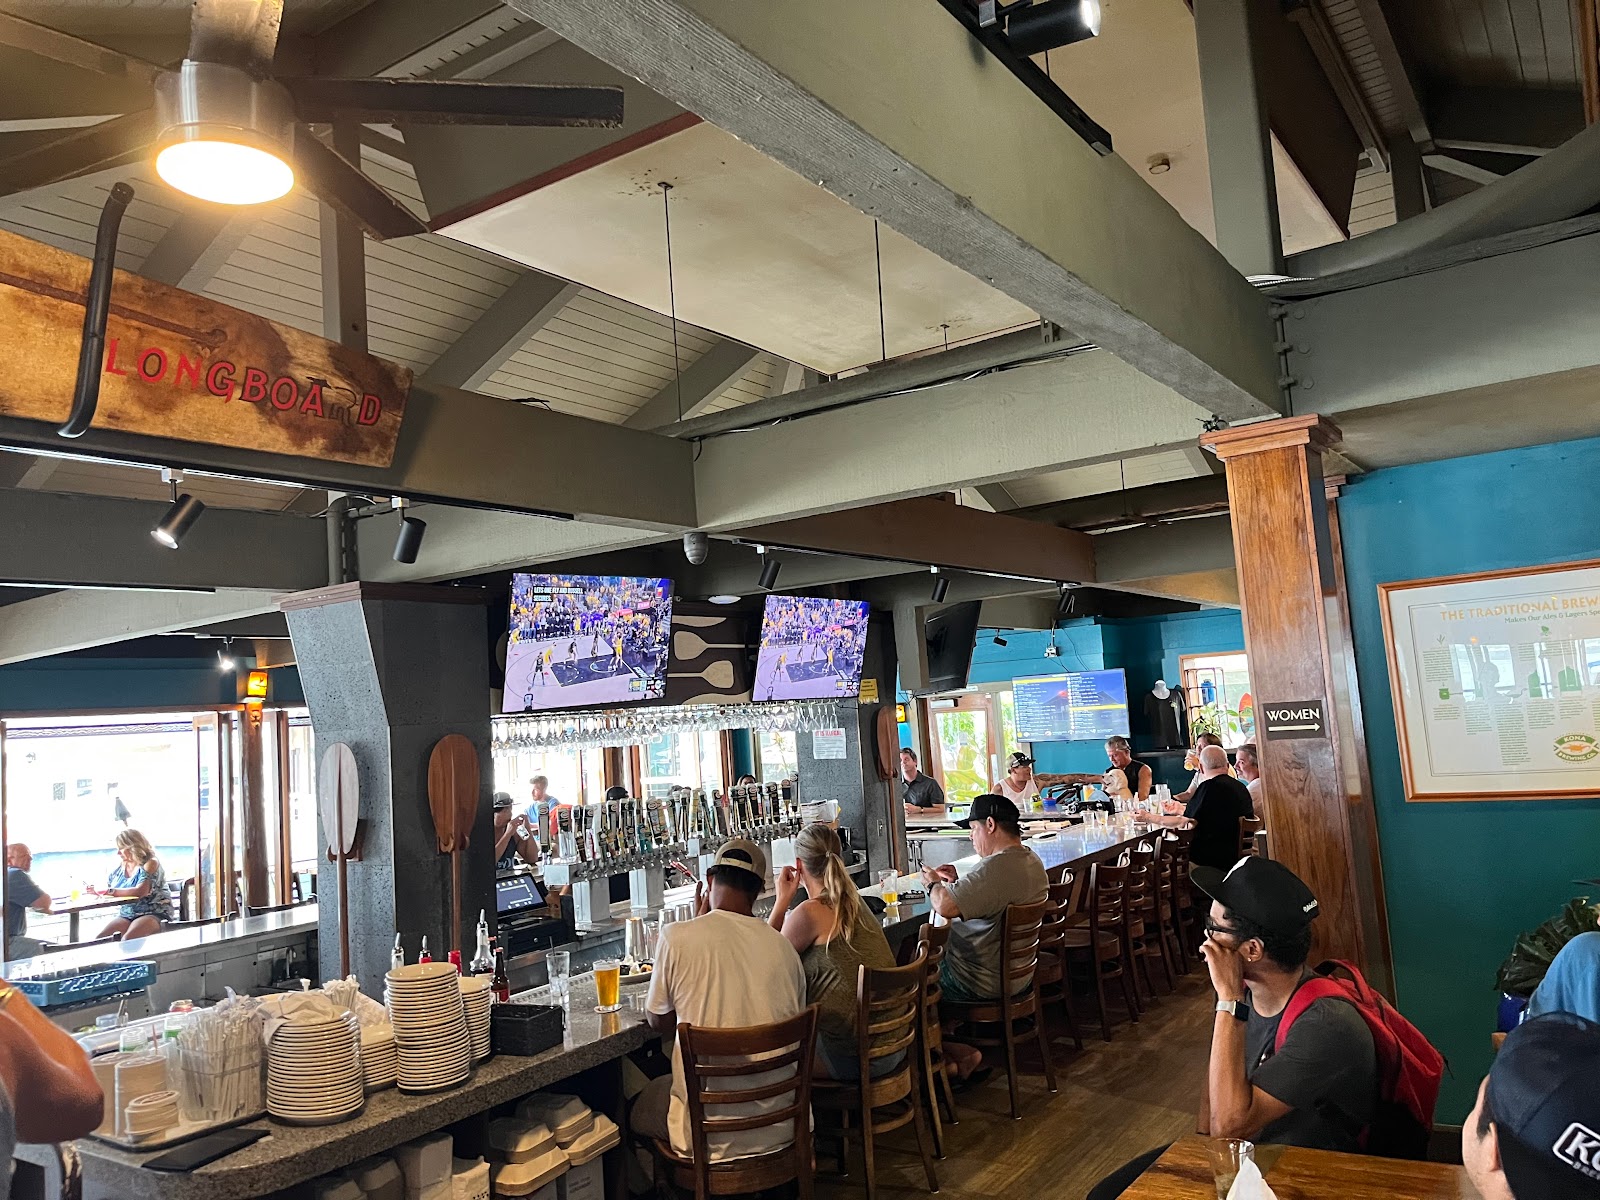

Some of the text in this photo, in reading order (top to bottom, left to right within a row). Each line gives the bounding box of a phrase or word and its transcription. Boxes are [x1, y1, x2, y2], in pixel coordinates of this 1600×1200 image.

[104, 337, 382, 427] LONGBOARD
[1440, 608, 1464, 621] THE
[1467, 600, 1558, 619] TRADITIONAL
[1504, 616, 1527, 624] Makes
[1528, 614, 1541, 622] Our
[1565, 611, 1588, 619] Lagers
[1266, 708, 1320, 721] WOMEN
[1558, 752, 1587, 761] BREWING
